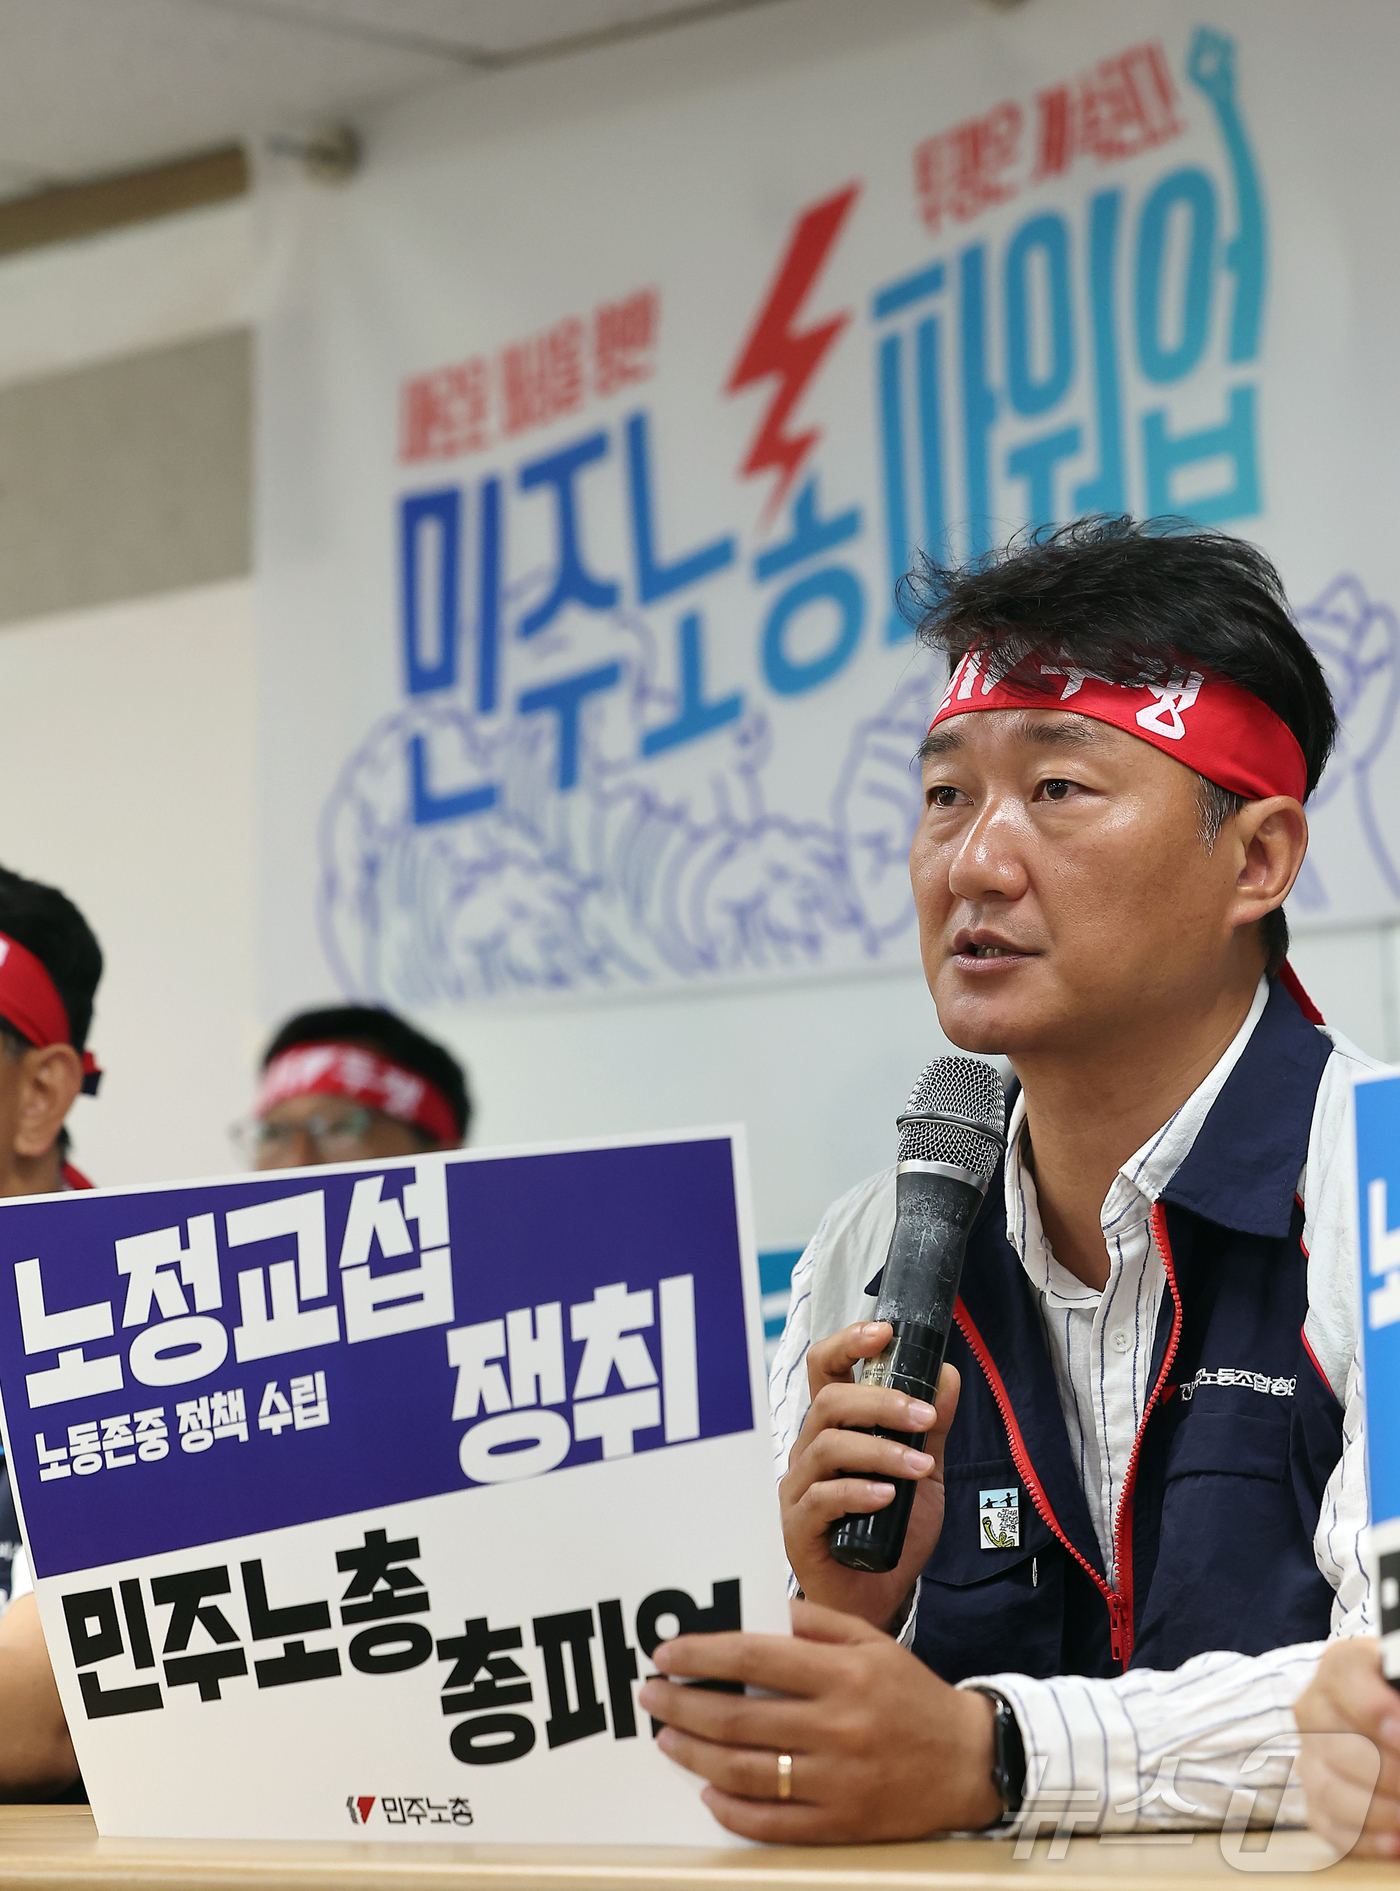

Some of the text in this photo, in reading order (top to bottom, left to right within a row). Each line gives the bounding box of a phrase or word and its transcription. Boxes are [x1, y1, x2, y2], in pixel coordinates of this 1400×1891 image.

[912, 42, 1190, 238] 투쟁은 계속된다!
[872, 28, 1268, 645] 파워업
[14, 1166, 454, 1408] 노정교섭
[446, 1273, 699, 1484] 쟁취
[35, 1370, 330, 1482] 노동존중 정책 수립
[61, 1528, 433, 1720] 민주노총
[381, 1797, 473, 1826] 민주노총
